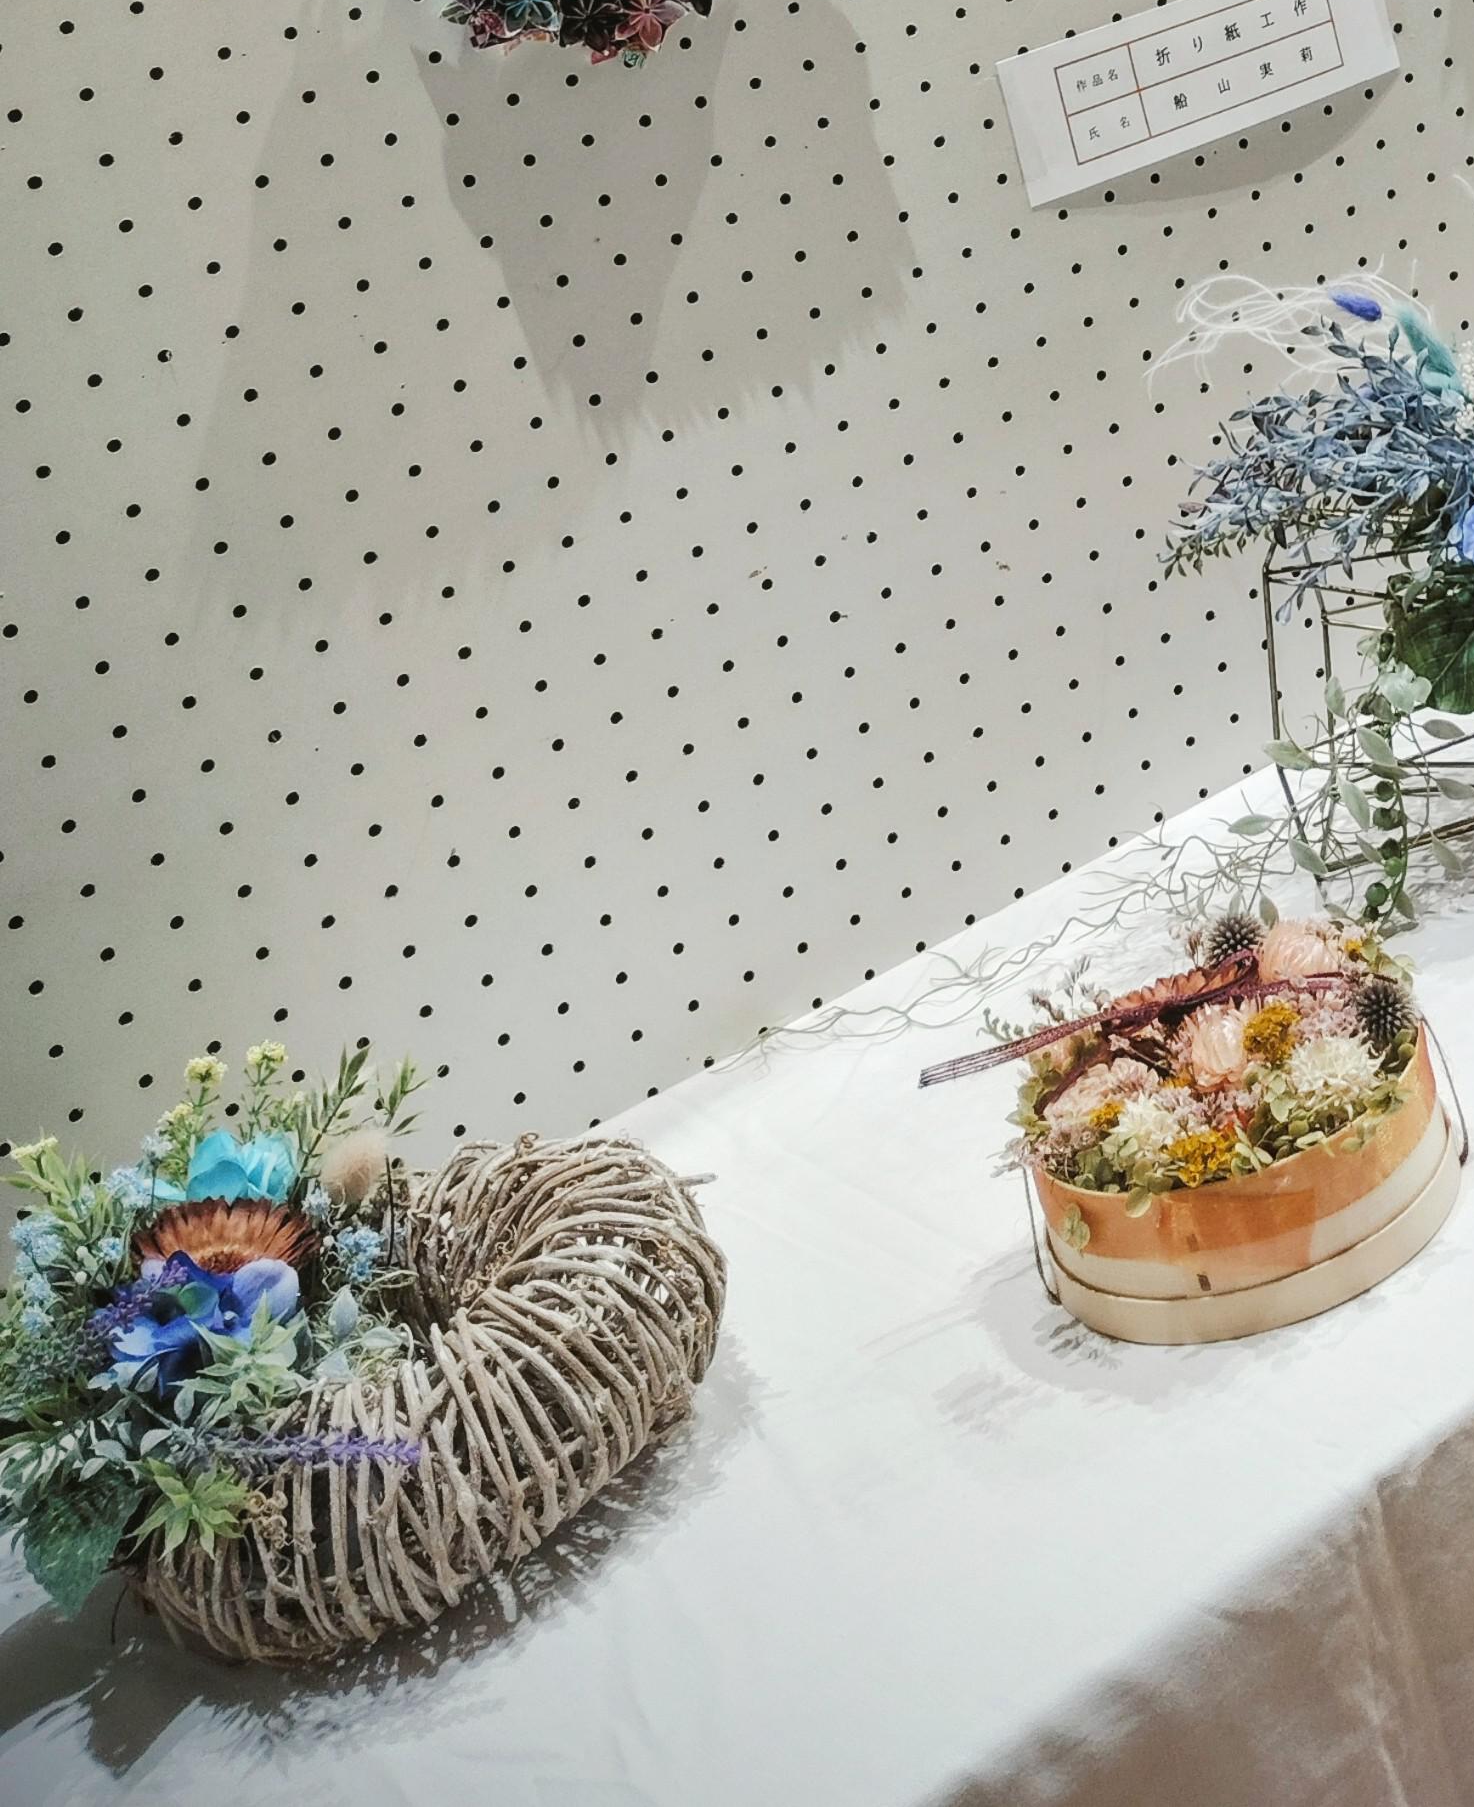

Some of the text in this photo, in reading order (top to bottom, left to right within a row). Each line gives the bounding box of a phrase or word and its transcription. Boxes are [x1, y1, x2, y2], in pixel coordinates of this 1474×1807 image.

[1076, 68, 1119, 93] 作品名
[1089, 116, 1131, 140] 氏名
